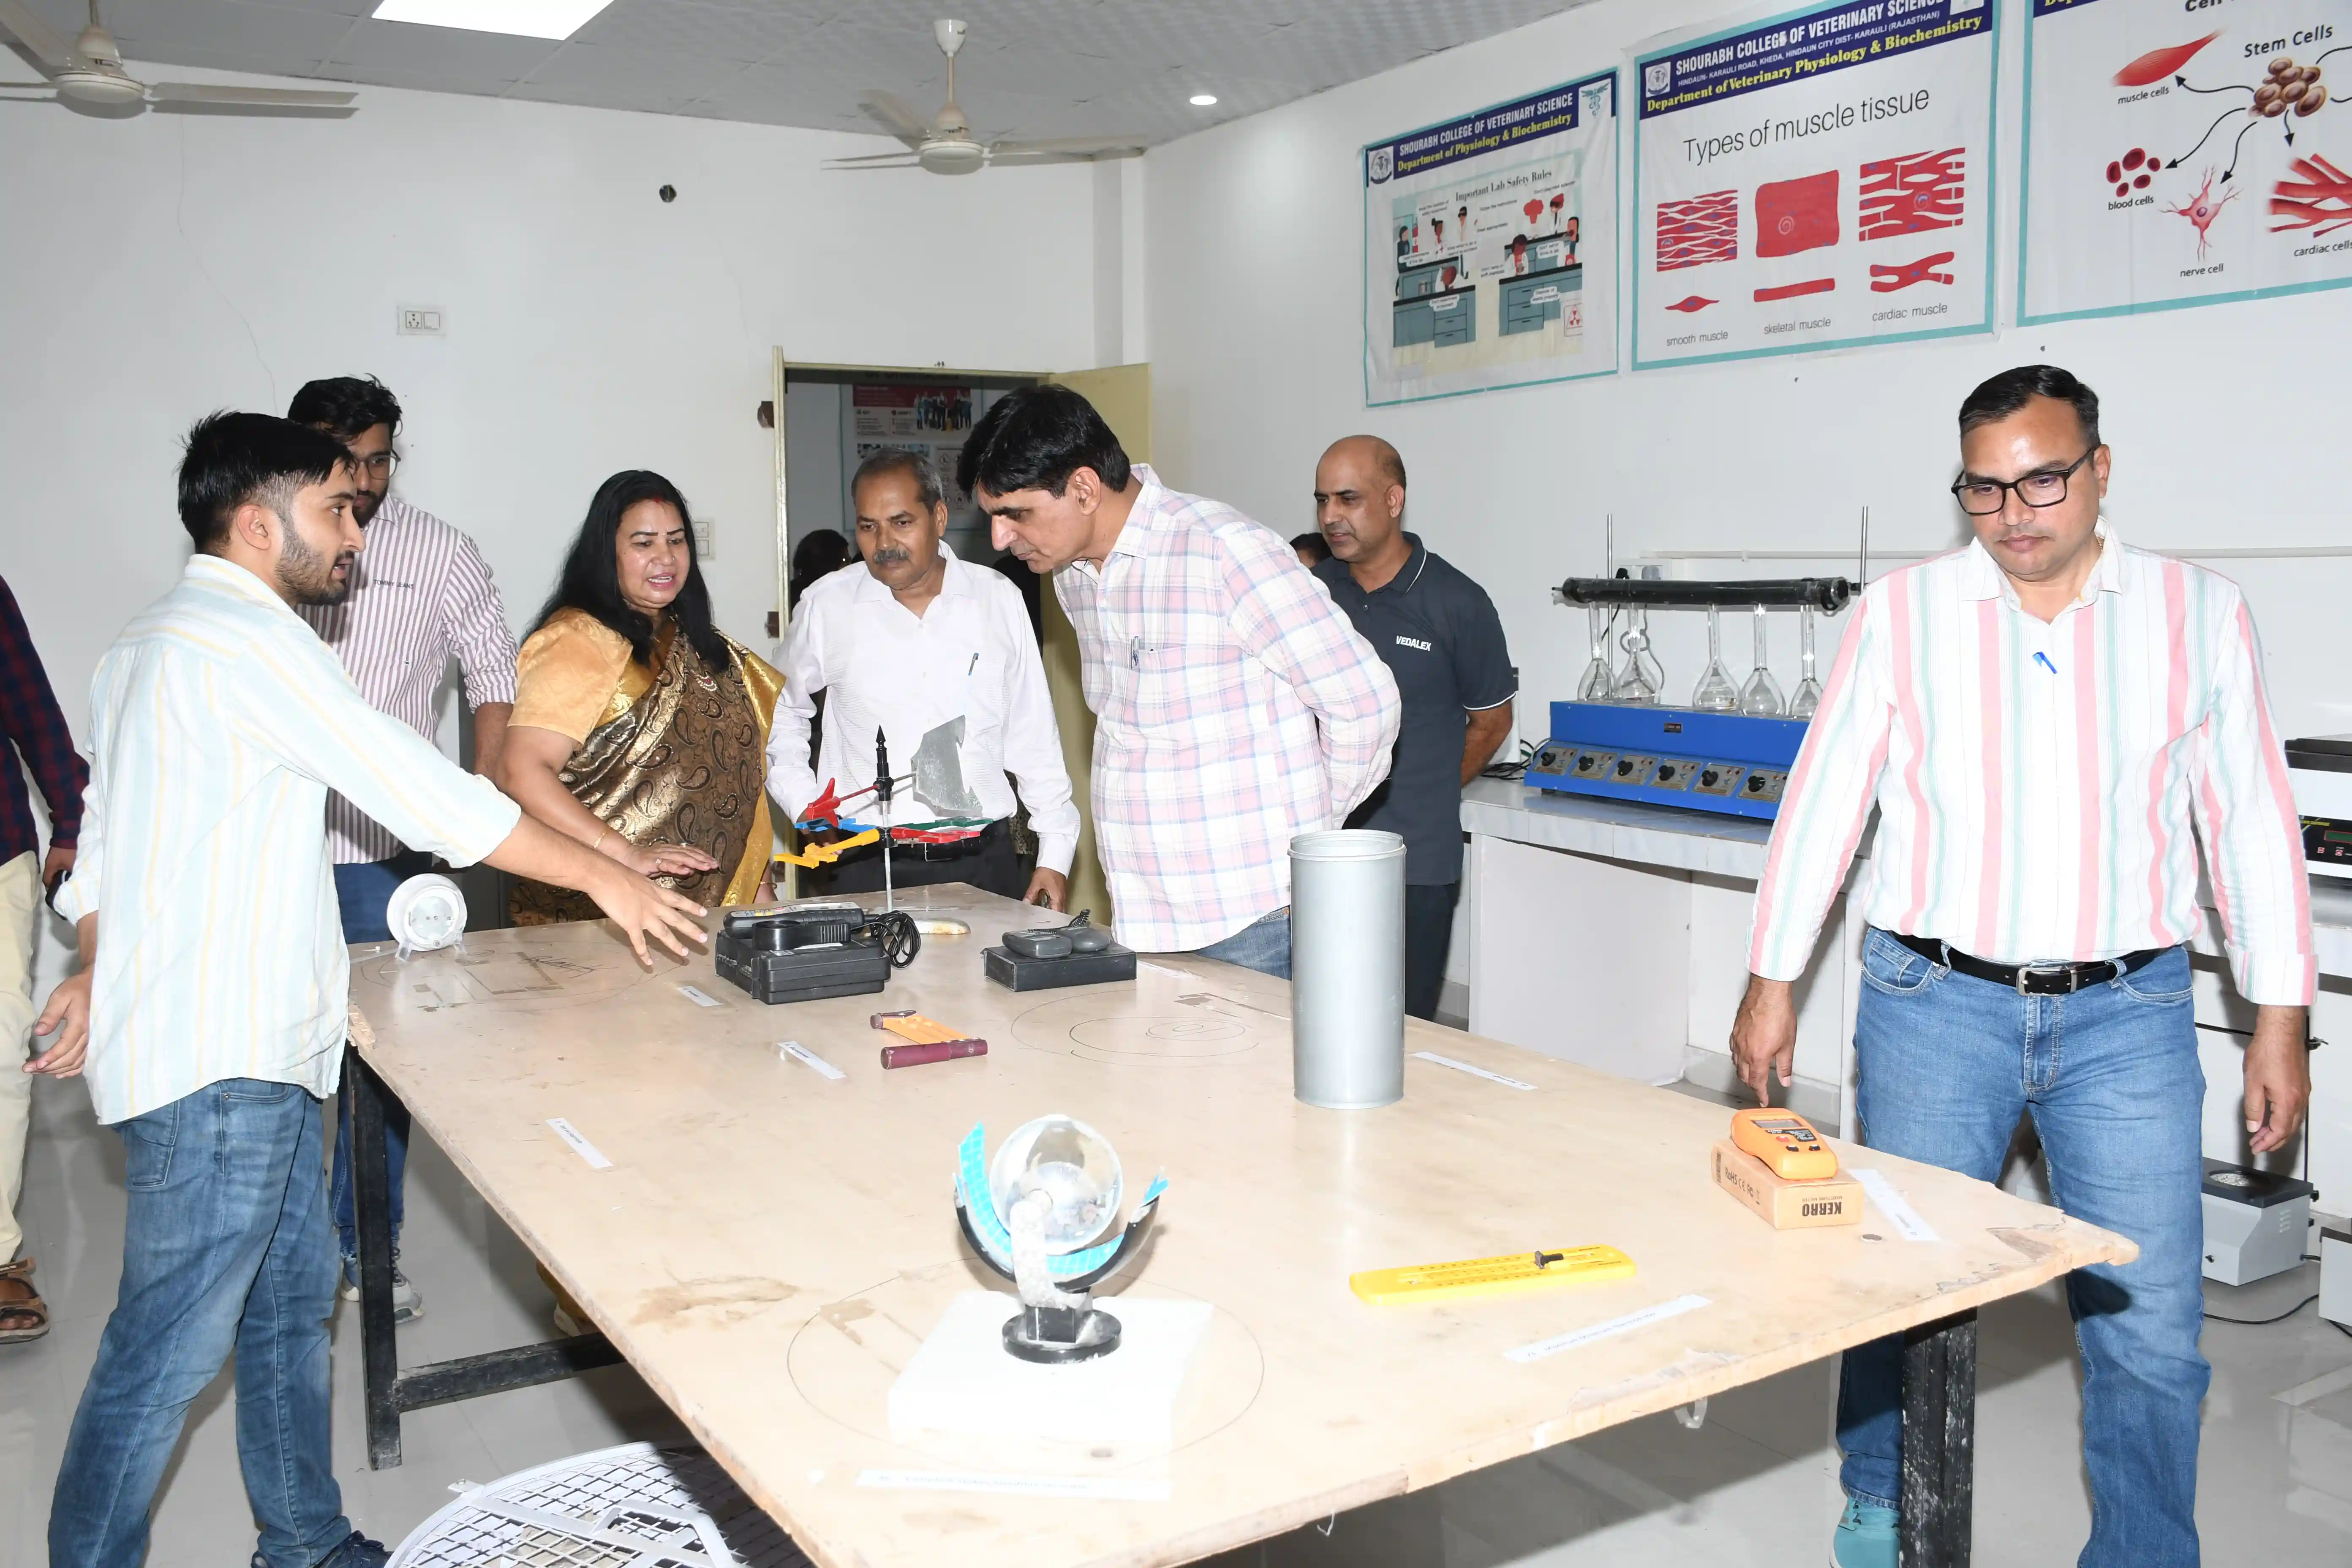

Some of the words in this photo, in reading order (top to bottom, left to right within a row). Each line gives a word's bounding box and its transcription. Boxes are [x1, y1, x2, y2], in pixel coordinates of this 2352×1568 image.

[1676, 46, 1734, 75] SHOURABH
[1737, 31, 1787, 58] COLLEGE
[1790, 25, 1805, 43] OF
[1808, 7, 1884, 38] VETERINARY
[1678, 75, 1708, 87] HINDAUN-
[1709, 66, 1737, 78] KARAULI
[1738, 60, 1758, 71] ROAD,
[1759, 53, 1784, 66] KHEDA,
[1786, 45, 1816, 60] HINDAUN
[1818, 39, 1833, 50] CITY
[1835, 35, 1854, 46] DIST-
[1854, 27, 1887, 41] KARAULI
[1889, 11, 1940, 32] (RAJASTHAN)
[2244, 36, 2286, 58] Stem
[2293, 24, 2333, 46] Cells
[1647, 84, 1712, 112] Department
[1715, 80, 1729, 96] of
[1729, 66, 1792, 90] Veterinary
[1795, 46, 1867, 74] Physiology
[1870, 40, 1881, 53] &
[1884, 16, 1983, 50] Biochemistry
[2118, 90, 2148, 105] muscle
[2150, 86, 2170, 100] cells
[1399, 135, 1438, 156] SHOURABH
[1440, 124, 1473, 144] COLLEGE
[1475, 120, 1485, 134] OF
[1487, 104, 1535, 130] VETERINARY
[1537, 93, 1573, 116] SCIENCE
[1683, 132, 1744, 166] Types
[1749, 119, 1772, 147] of
[1775, 103, 1854, 143] muscle
[1860, 88, 1930, 122] tissue
[1398, 150, 1443, 171] Department
[1445, 145, 1454, 158] of
[1455, 132, 1500, 157] Physiology
[1503, 129, 1510, 141] &
[1512, 113, 1572, 139] Biochemistry
[1455, 184, 1489, 202] Important
[1491, 181, 1505, 194] Lab
[1507, 174, 1529, 189] Safety
[1532, 169, 1552, 182] Rules
[2108, 197, 2133, 210] blood
[2134, 195, 2154, 207] cells
[2294, 244, 2330, 256] cardiac
[2180, 267, 2205, 278] nerve
[2208, 263, 2224, 275] cell
[1872, 307, 1907, 323] cardiac
[1911, 302, 1948, 318] muscle
[1764, 319, 1796, 335] skeletal
[1799, 317, 1831, 331] muscle
[1666, 333, 1696, 346] smooth
[1699, 329, 1729, 343] muscle
[1396, 635, 1432, 652] VEDALEX
[1725, 1167, 1737, 1185] RoHS
[1802, 1201, 1842, 1217] KERRO
